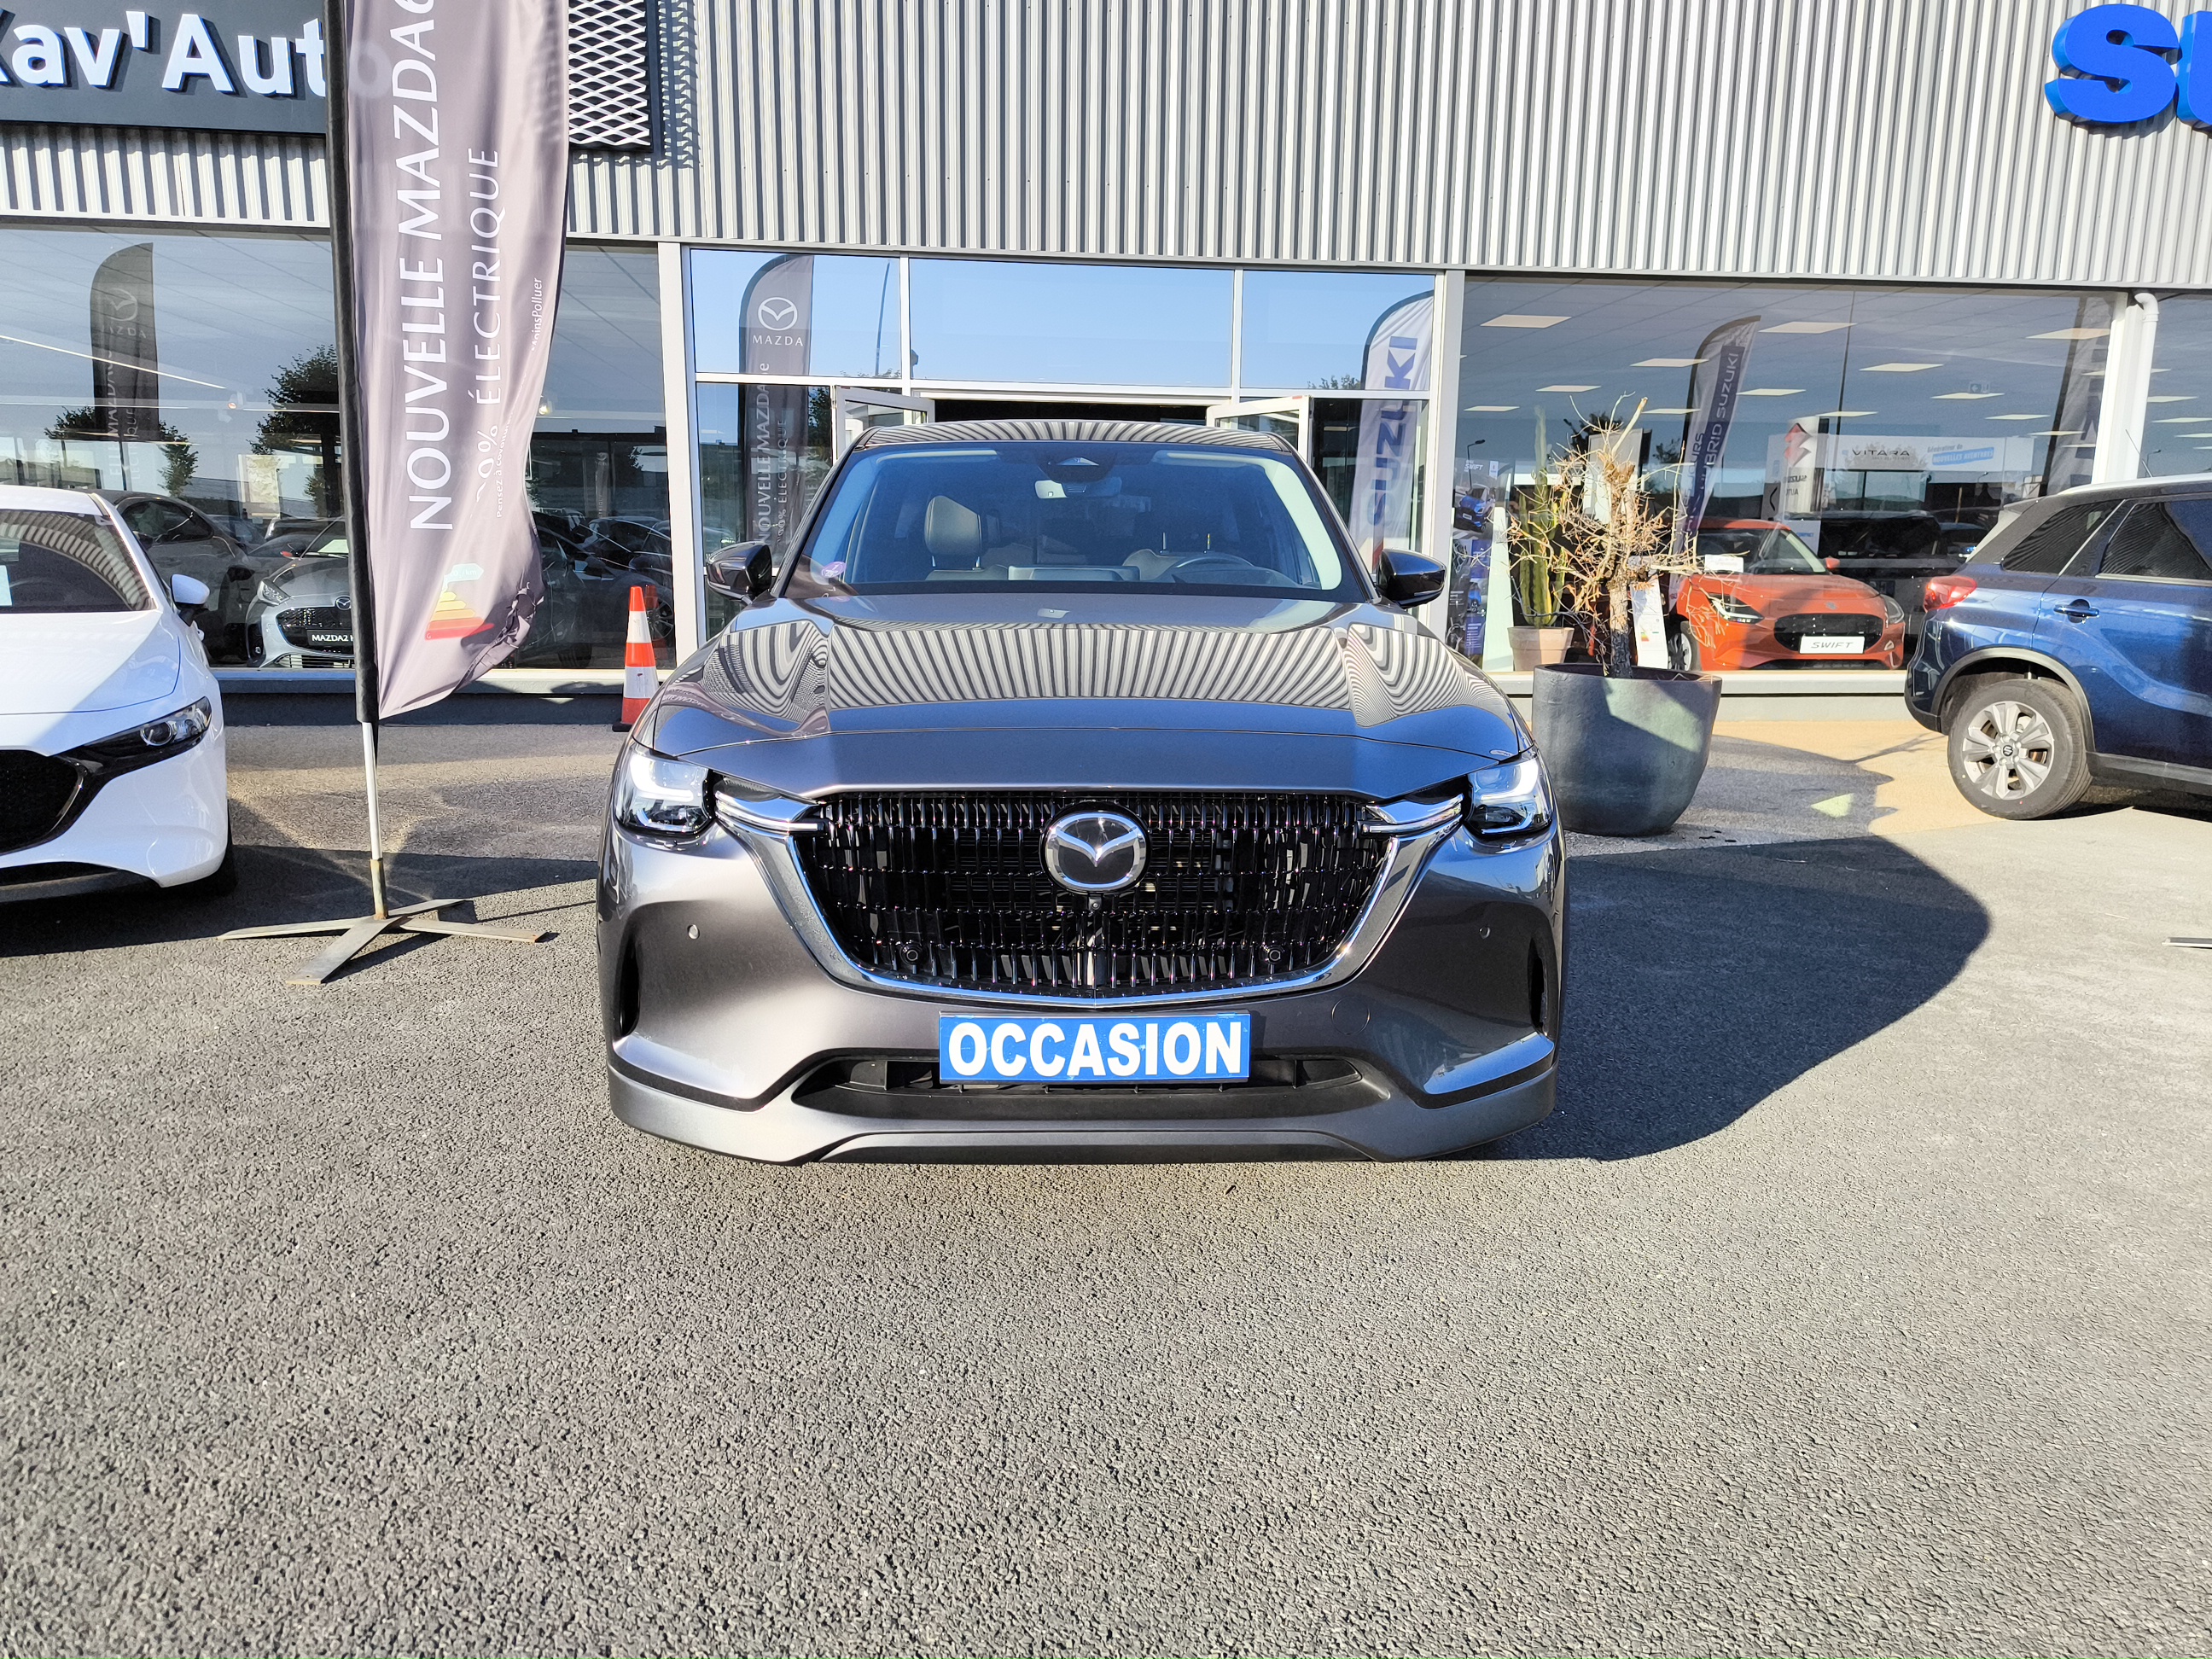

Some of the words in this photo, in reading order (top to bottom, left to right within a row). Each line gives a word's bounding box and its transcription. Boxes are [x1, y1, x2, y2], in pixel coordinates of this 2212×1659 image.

[468, 148, 505, 405] ÉLECTRIQUE
[752, 335, 804, 346] MAZDA
[399, 257, 453, 530] NOUVELLE
[757, 363, 771, 451] MAZDAe
[1716, 352, 1739, 420] SUZUKI
[948, 1022, 1242, 1077] OCCASION
